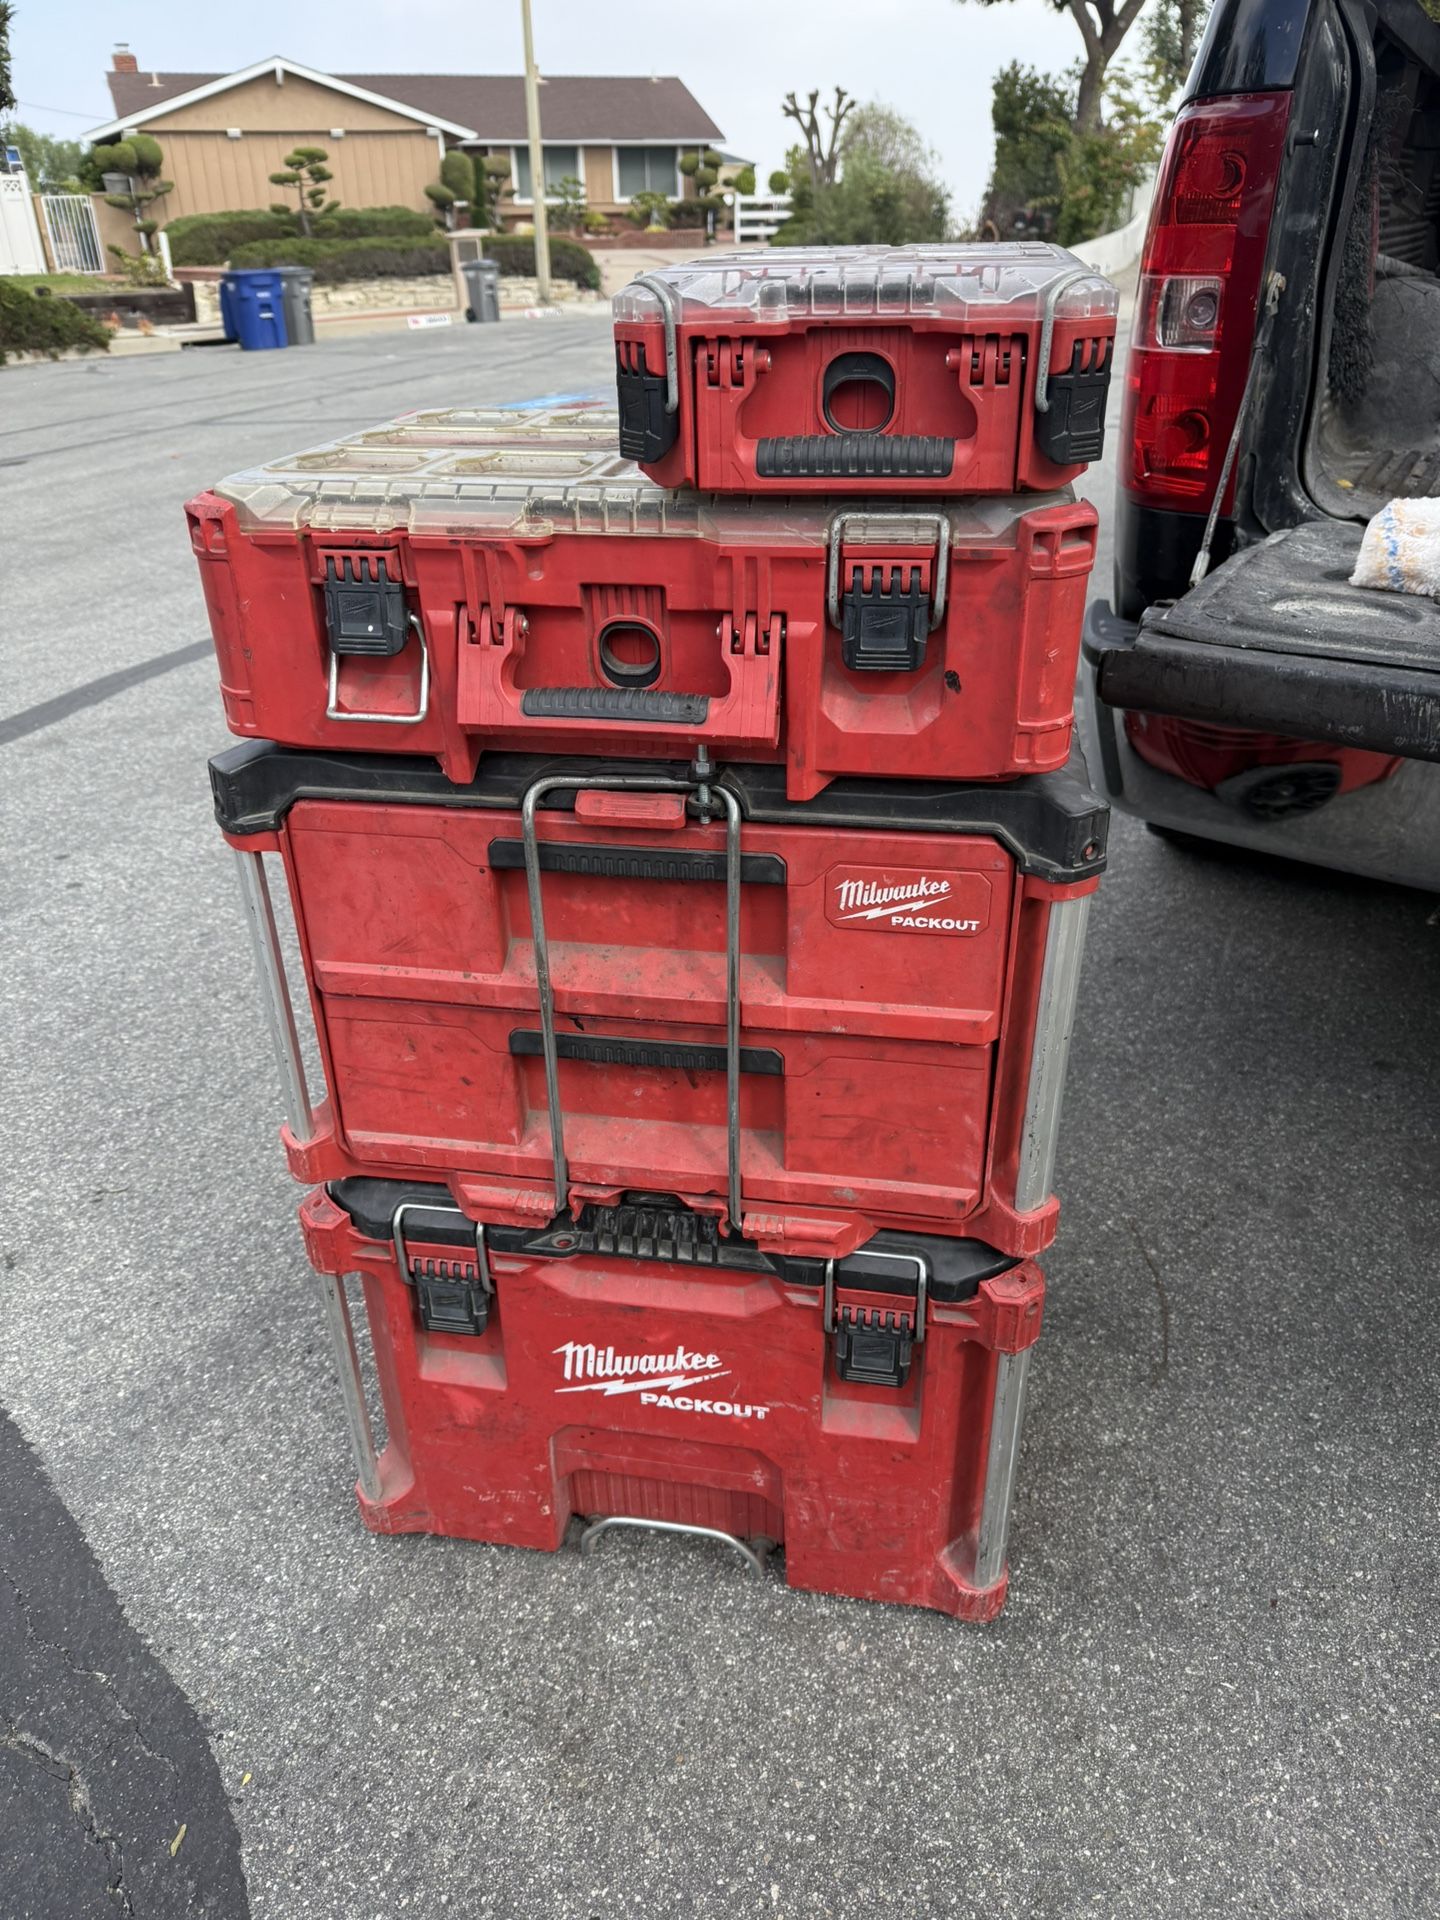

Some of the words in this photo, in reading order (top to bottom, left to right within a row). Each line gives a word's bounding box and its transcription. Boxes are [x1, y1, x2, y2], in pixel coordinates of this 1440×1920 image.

[834, 876, 951, 911] Milwaukee
[891, 916, 981, 931] PACKOUT
[552, 1341, 723, 1380] Milwaukee
[640, 1392, 770, 1419] PACKOUT
